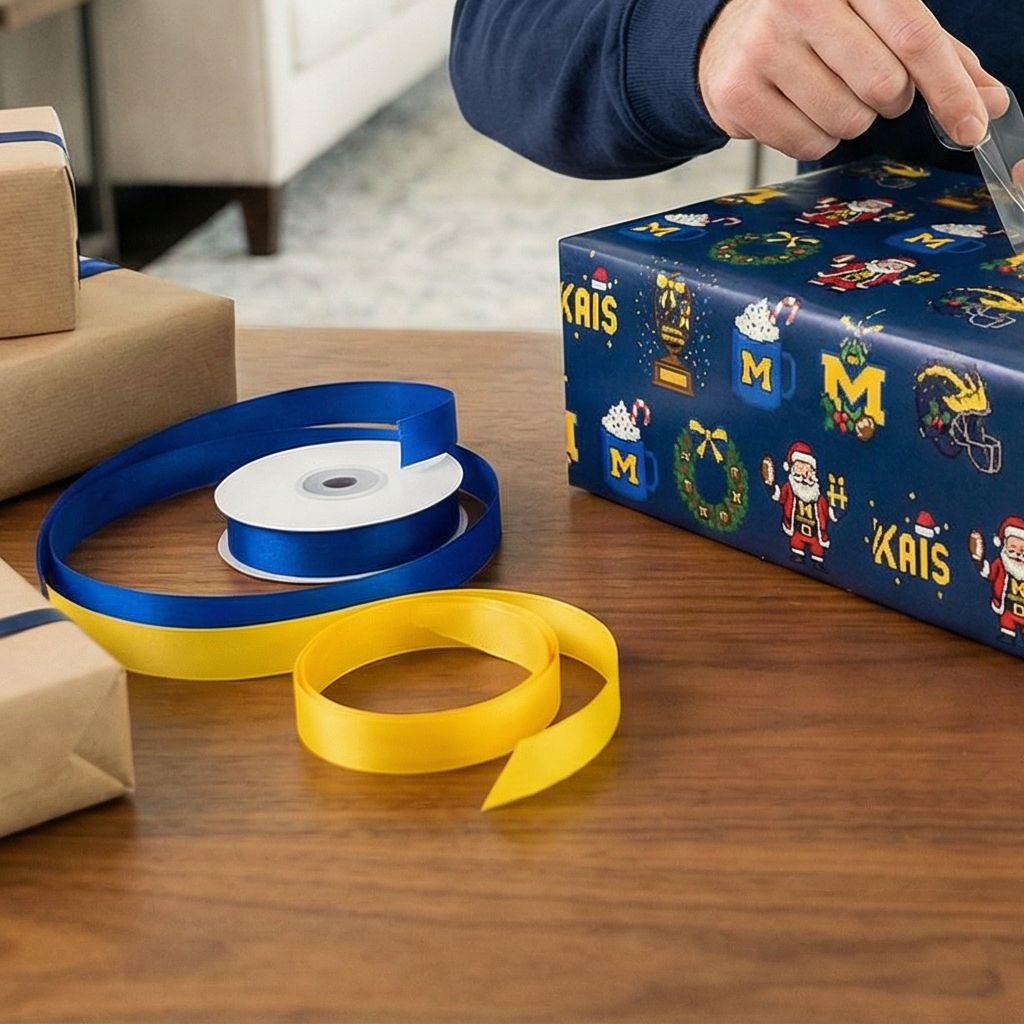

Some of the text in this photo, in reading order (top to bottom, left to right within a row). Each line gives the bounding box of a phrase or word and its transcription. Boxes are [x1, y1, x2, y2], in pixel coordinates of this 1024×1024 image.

[903, 232, 956, 249] M
[741, 350, 772, 393] M
[821, 352, 886, 427] M
[609, 447, 640, 486] M
